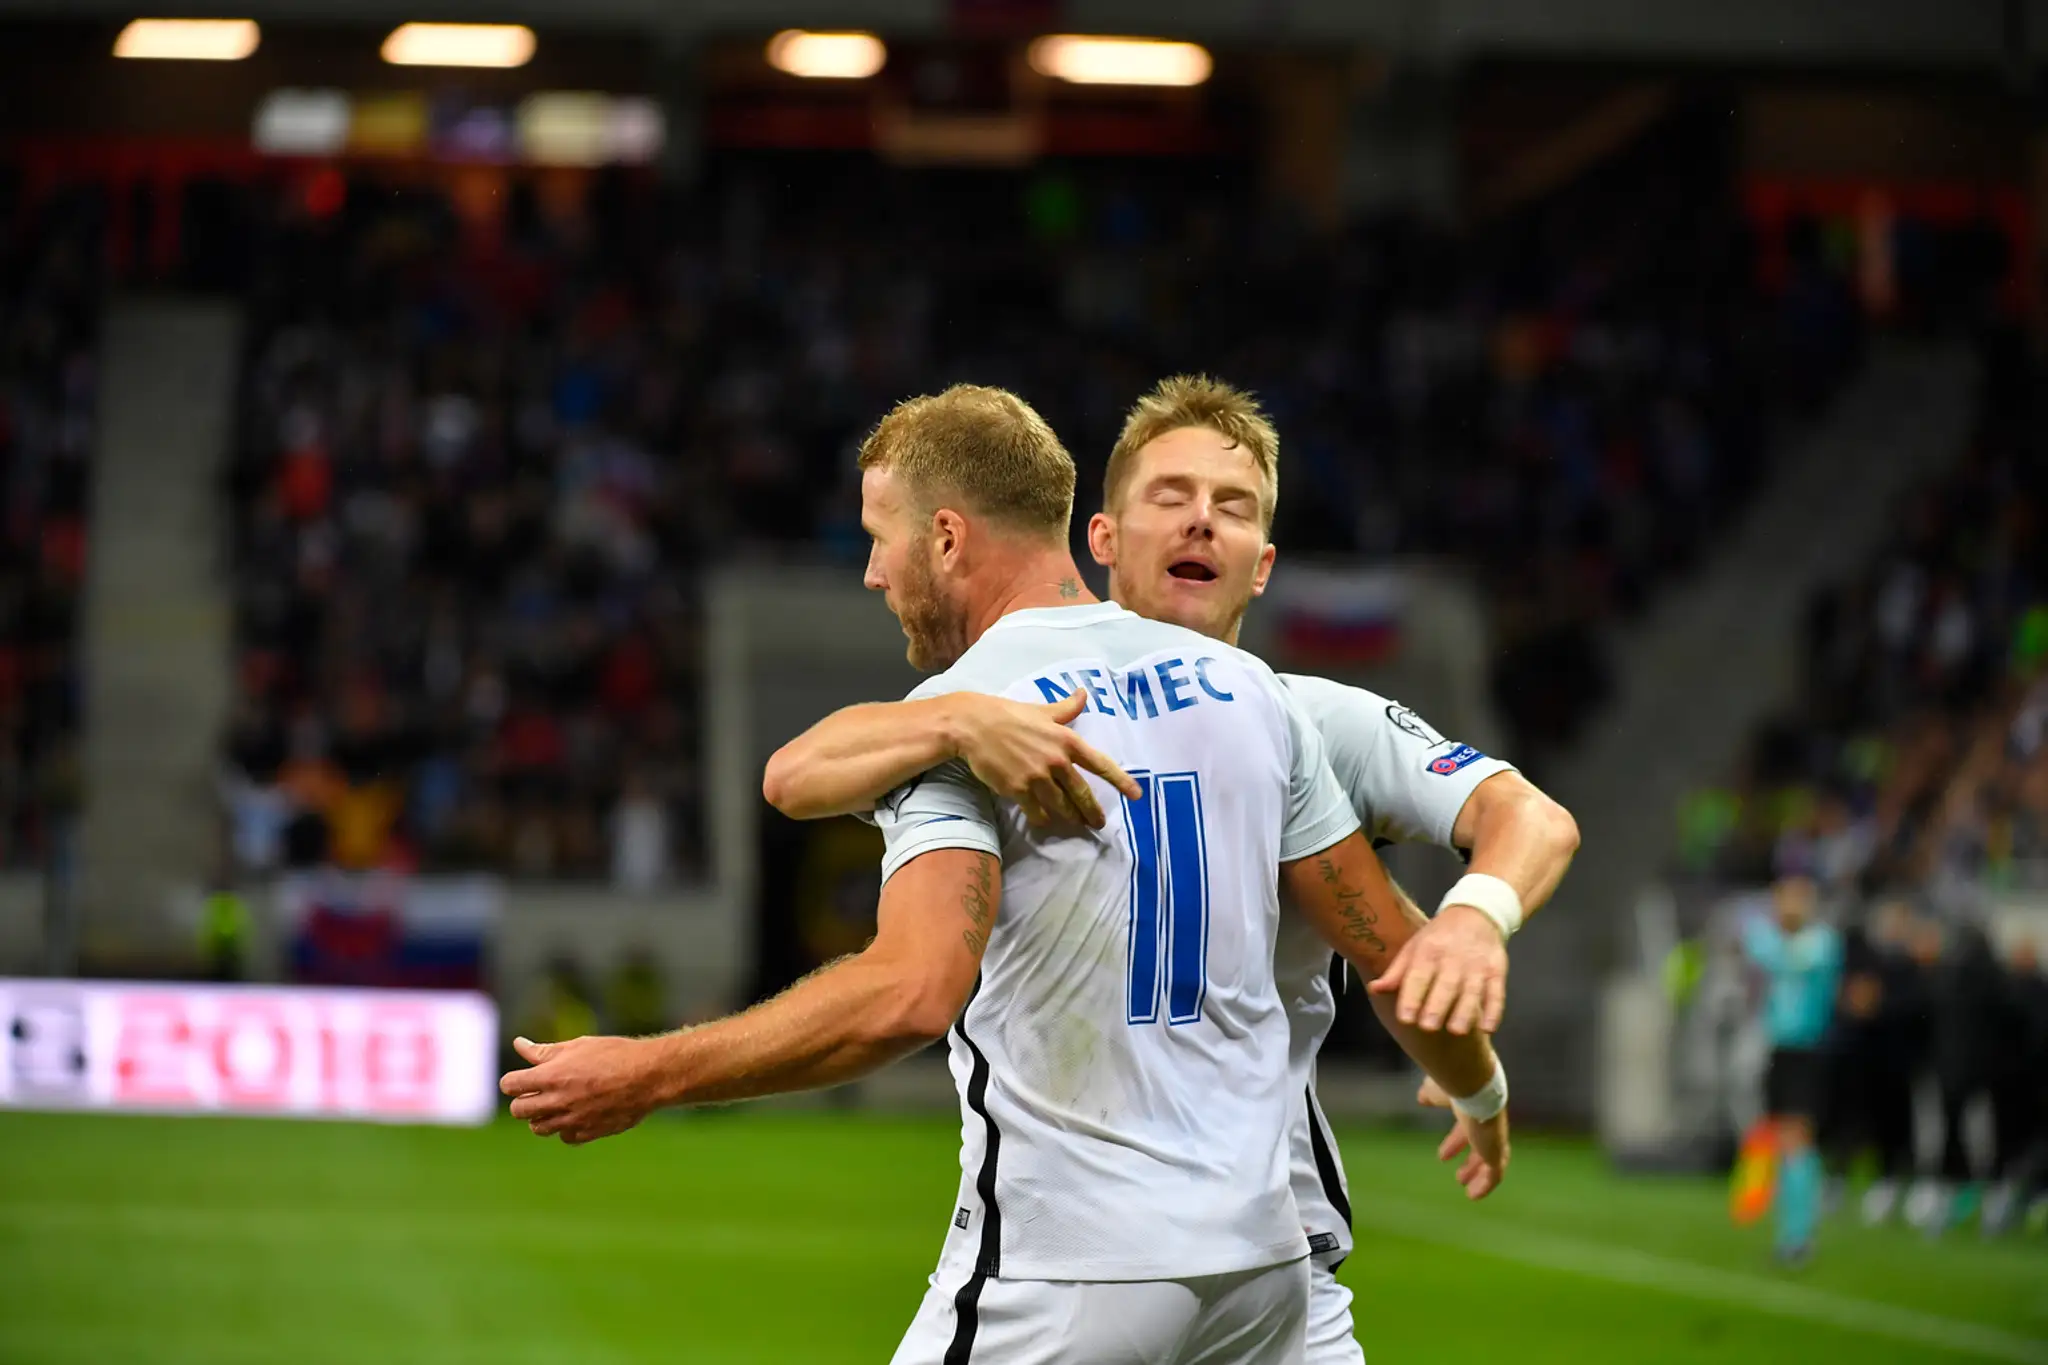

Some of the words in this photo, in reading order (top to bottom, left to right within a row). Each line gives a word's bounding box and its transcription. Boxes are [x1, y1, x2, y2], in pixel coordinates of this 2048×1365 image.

[1034, 656, 1234, 720] NEMEC
[1121, 769, 1210, 1026] 11
[117, 993, 439, 1109] 2018
